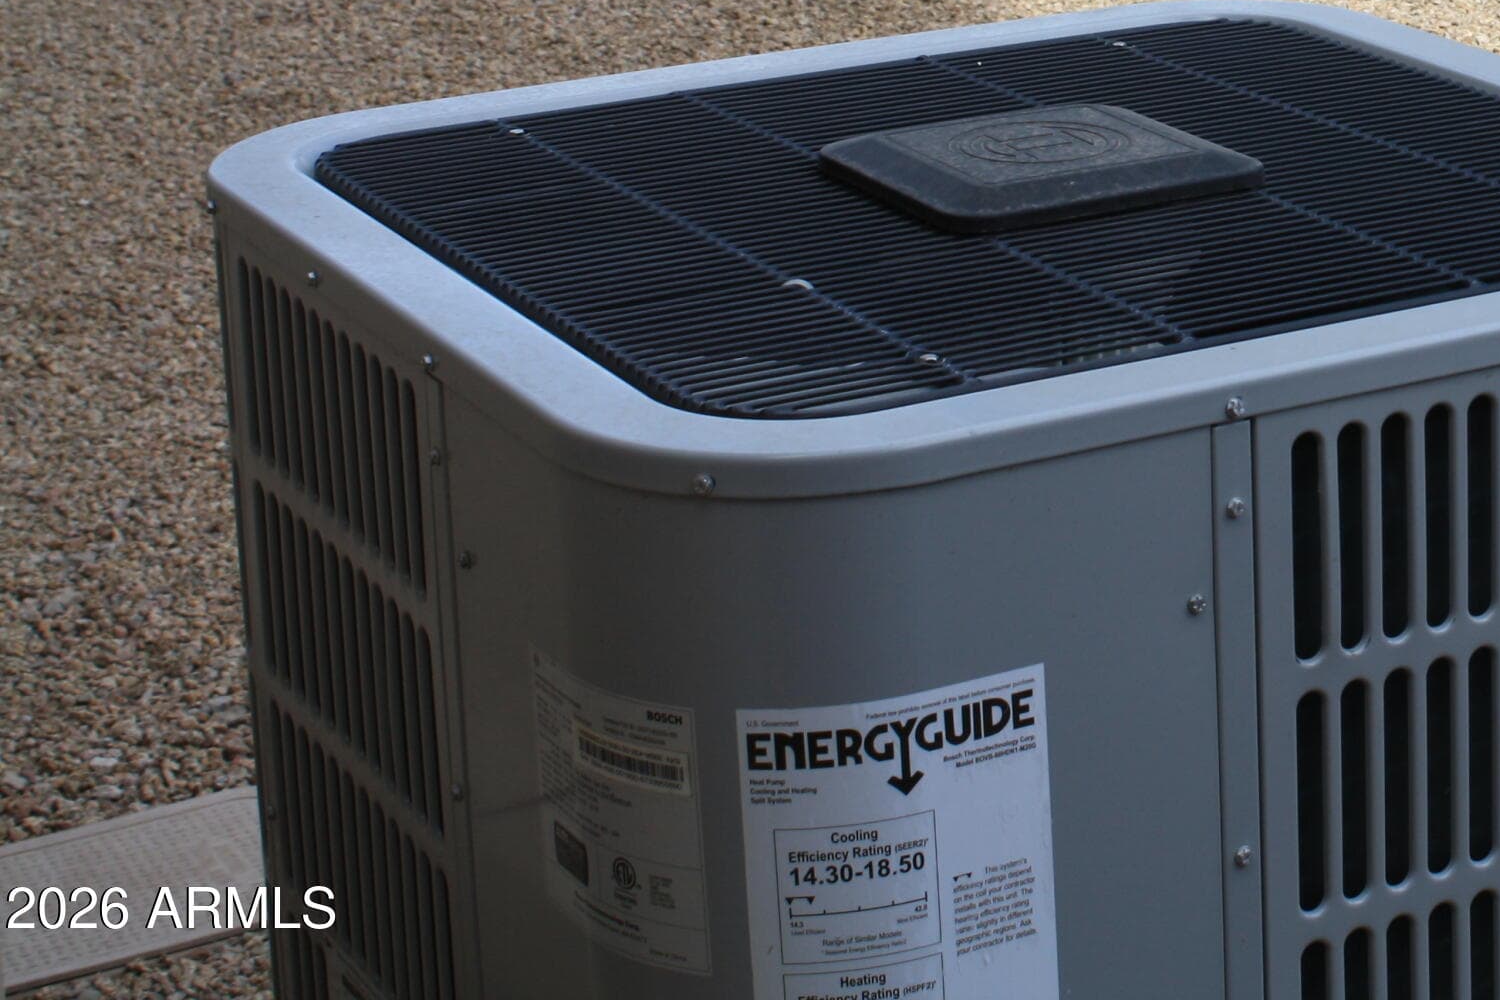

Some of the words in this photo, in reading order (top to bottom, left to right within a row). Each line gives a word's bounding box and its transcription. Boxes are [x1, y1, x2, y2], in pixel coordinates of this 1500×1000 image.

[646, 710, 683, 725] BOSCH
[746, 689, 1035, 770] ENERGYGUIDE
[751, 788, 776, 796] Cooling
[791, 787, 817, 795] Heating
[767, 797, 792, 805] System
[831, 830, 879, 843] Cooling
[788, 850, 849, 863] Efficiency
[853, 843, 892, 859] Rating
[790, 852, 925, 887] 14.30-18.50
[1008, 865, 1032, 879] depend
[963, 893, 974, 901] the
[975, 888, 987, 898] coil
[988, 885, 1003, 896] your
[1004, 876, 1036, 890] contractor
[992, 895, 1005, 904] this
[1021, 887, 1033, 896] The
[1020, 918, 1032, 927] Ask
[840, 973, 886, 988] Heating
[861, 988, 900, 1000] Rating
